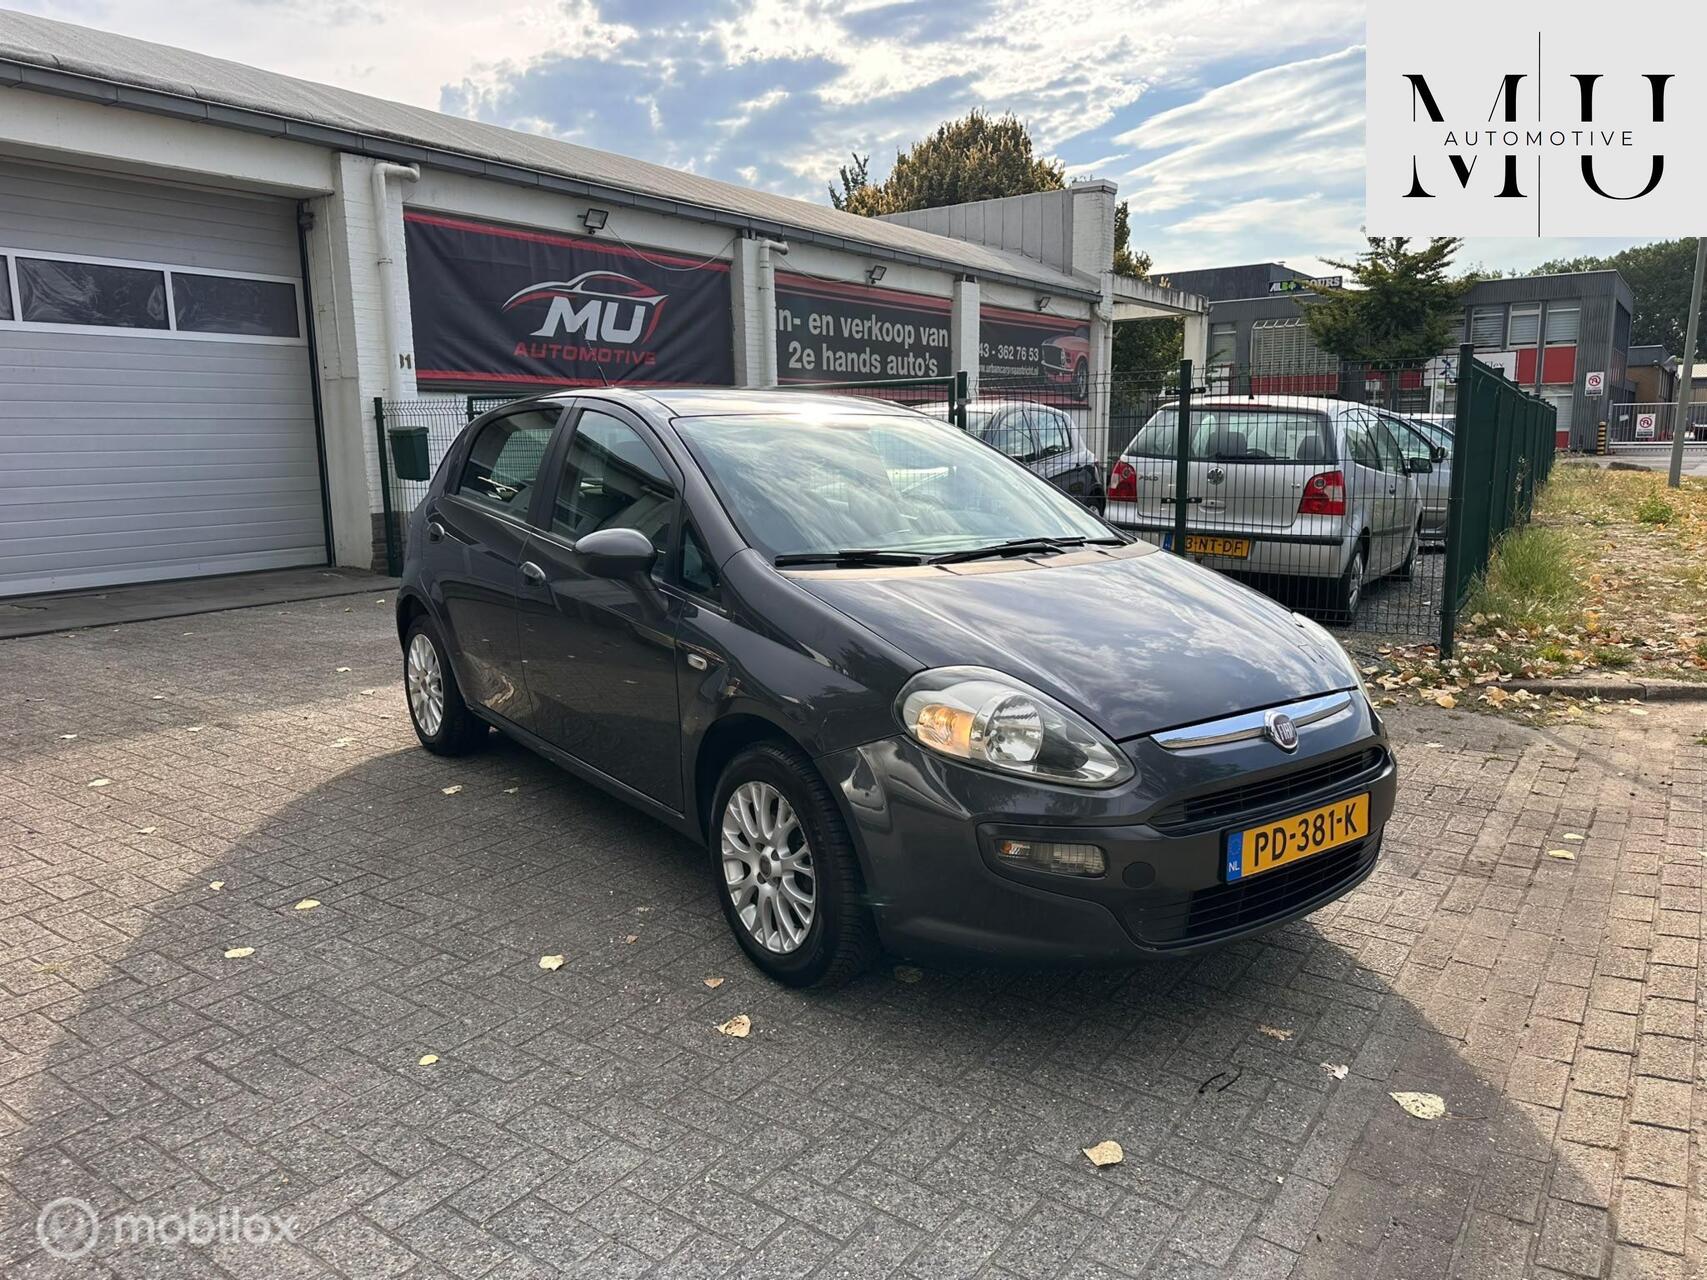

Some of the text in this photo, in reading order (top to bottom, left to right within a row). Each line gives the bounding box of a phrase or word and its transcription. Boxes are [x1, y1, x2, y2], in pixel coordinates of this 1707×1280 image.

[530, 296, 646, 344] MU
[808, 313, 834, 336] en
[840, 314, 915, 349] verkoop
[920, 326, 949, 348] van
[514, 342, 656, 365] AUTOMOTIVE
[788, 340, 938, 377] 2e hands auto's
[997, 345, 1014, 360] 362
[1016, 346, 1027, 361] 76
[1028, 347, 1039, 362] 53
[1185, 537, 1244, 553] 3-NT-DF
[1228, 802, 1358, 872] NL PD-381-K
